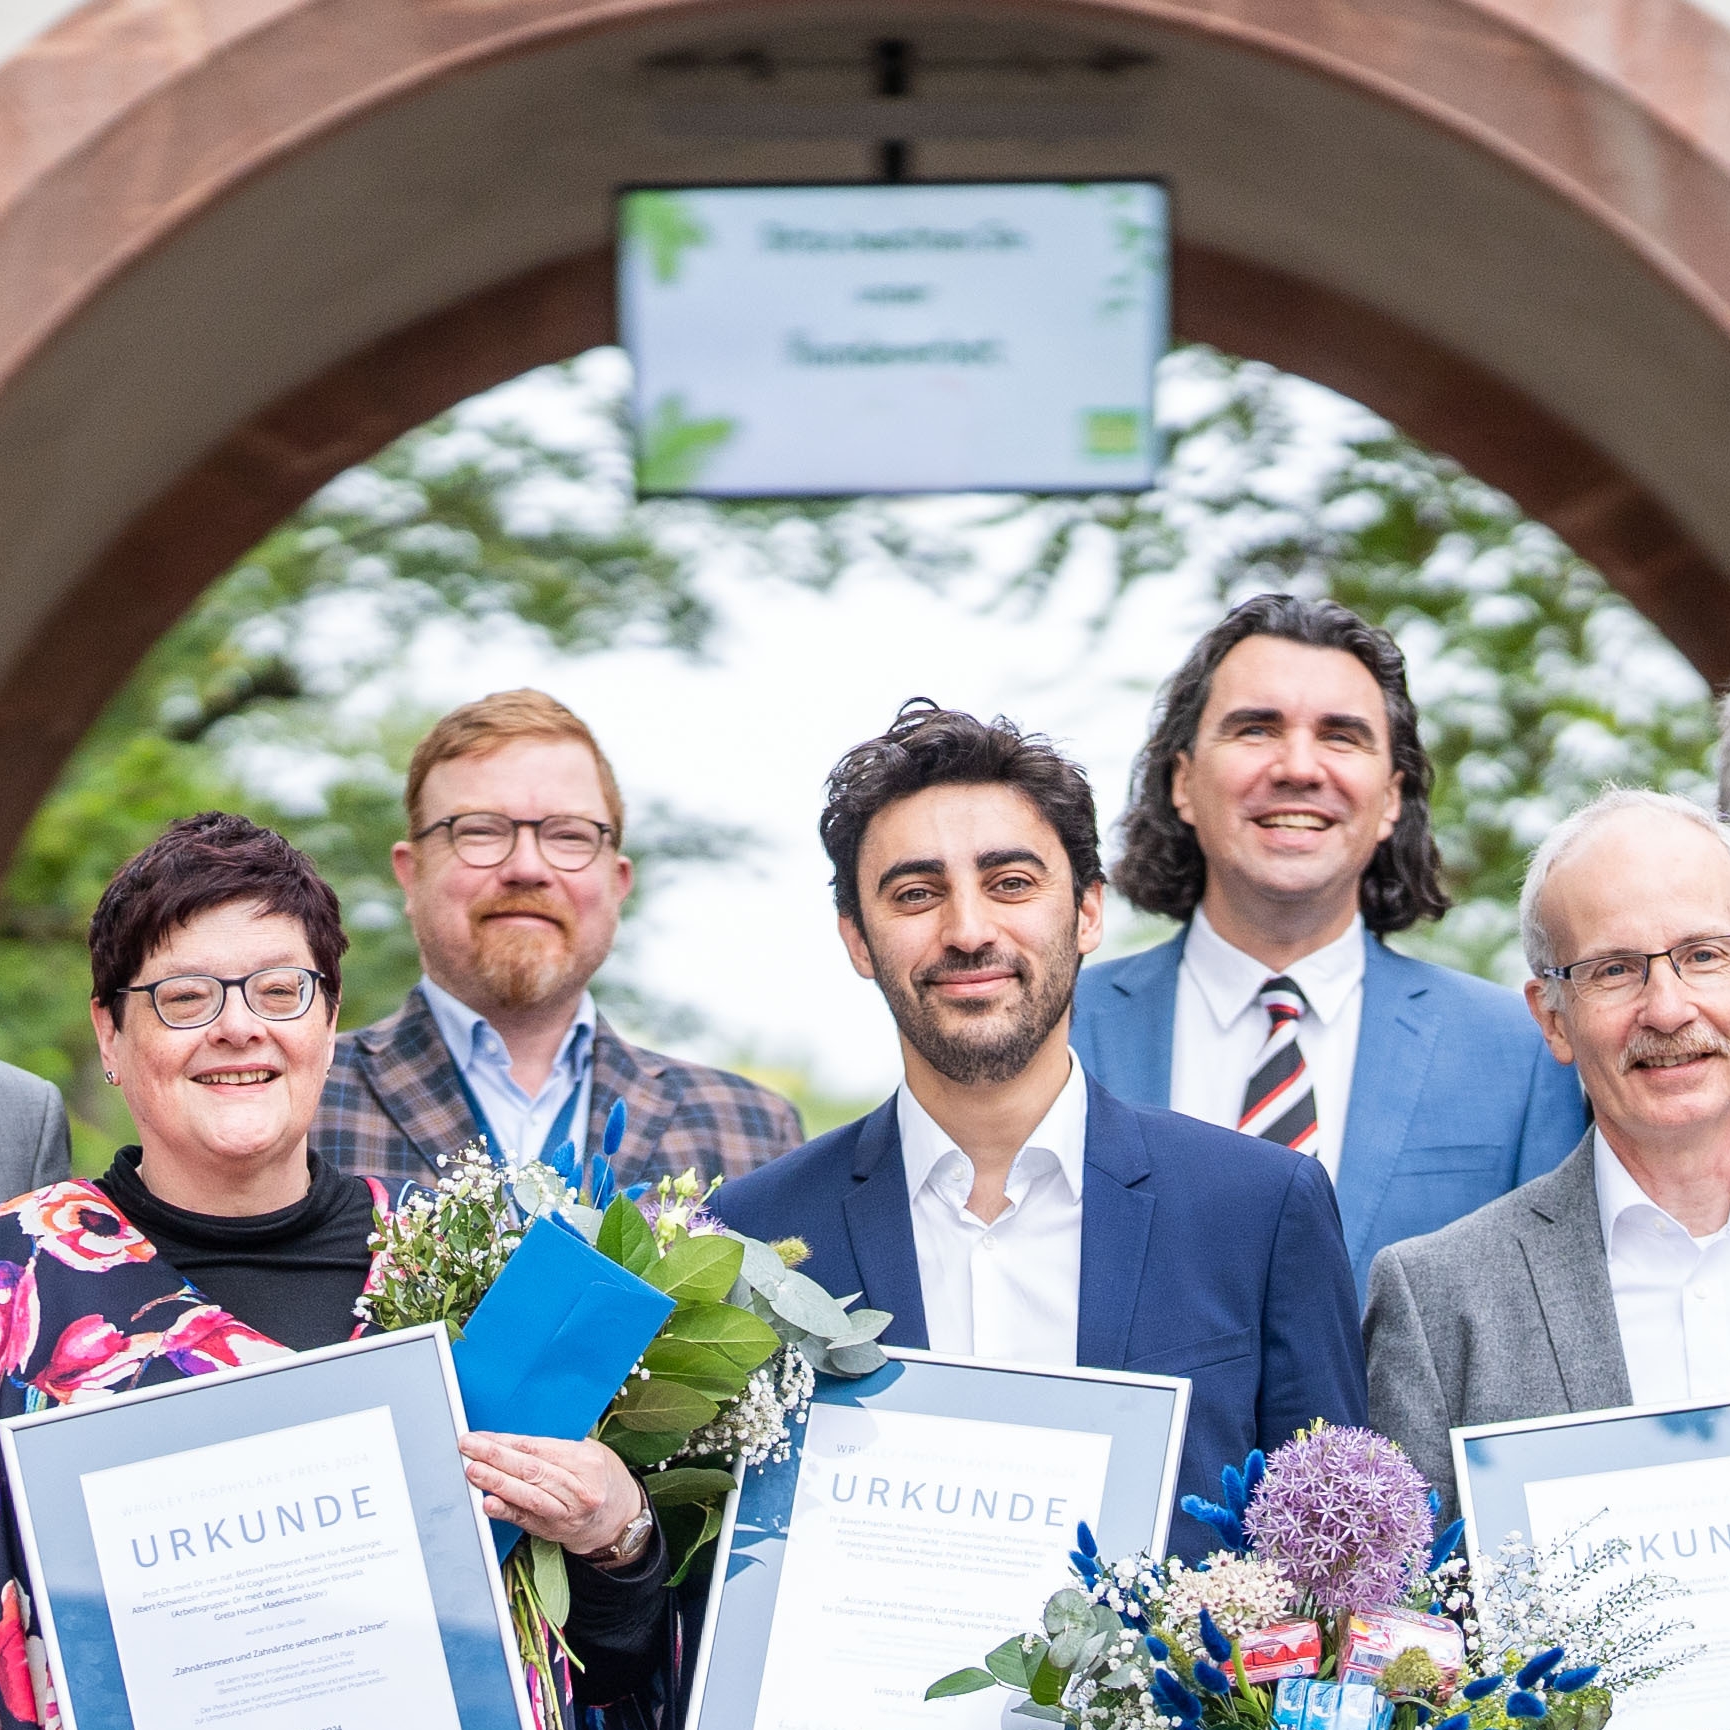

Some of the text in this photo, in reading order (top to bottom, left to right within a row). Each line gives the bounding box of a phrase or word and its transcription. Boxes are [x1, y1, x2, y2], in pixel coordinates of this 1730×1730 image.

[120, 1493, 184, 1518] WRIGLEY
[286, 1460, 329, 1480] PREIS
[333, 1451, 370, 1469] 2024
[829, 1472, 1068, 1527] URKUNDE
[130, 1484, 377, 1570] URKUNDE
[233, 1650, 252, 1663] und
[251, 1640, 295, 1659] Zahnärzte
[294, 1634, 321, 1649] sehen
[320, 1629, 344, 1643] mehr
[343, 1626, 358, 1638] als
